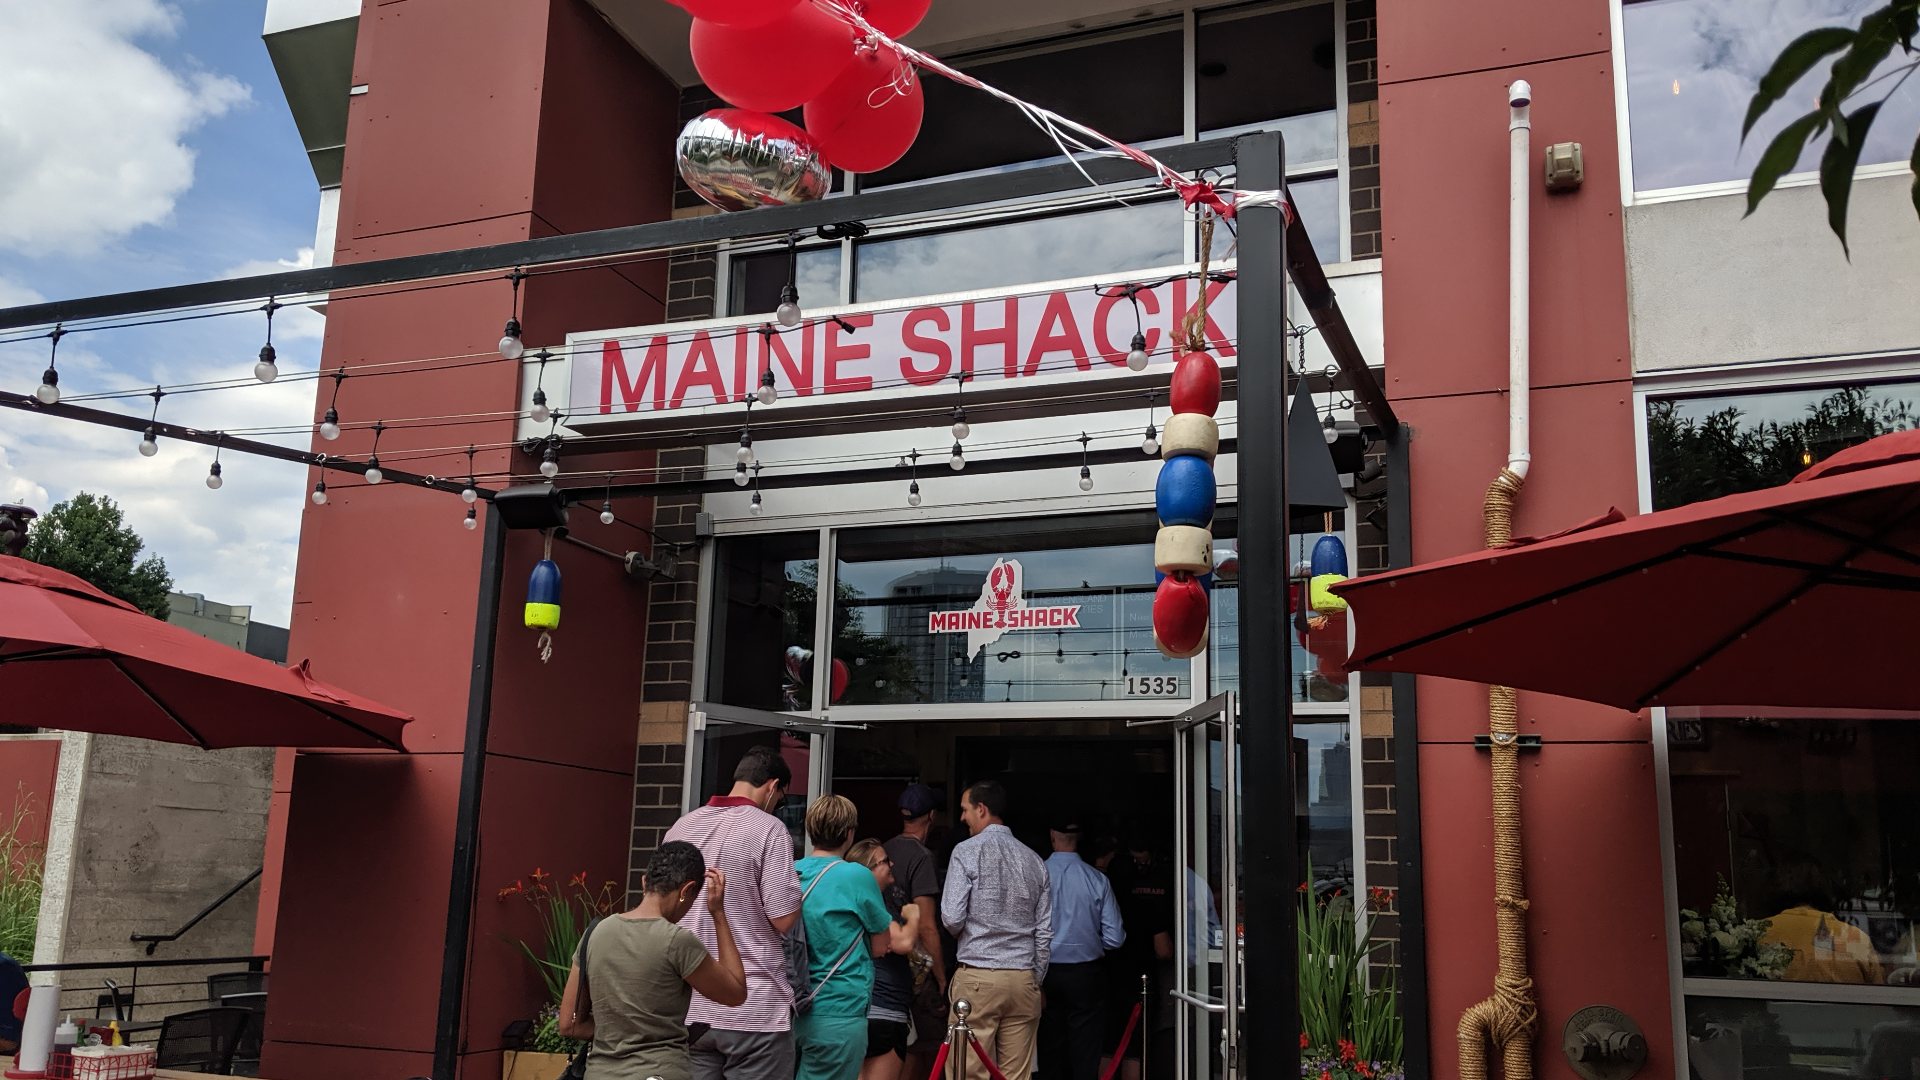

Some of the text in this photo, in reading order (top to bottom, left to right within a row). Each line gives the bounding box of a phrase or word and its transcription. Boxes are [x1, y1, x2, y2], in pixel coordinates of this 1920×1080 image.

[600, 271, 1237, 414] MAINE SHACK
[1040, 594, 1107, 605] NEW ENGLAND
[1124, 592, 1151, 601] LOBS
[1081, 604, 1105, 614] TIES
[930, 607, 1078, 631] MAINE SHACK
[1127, 676, 1178, 695] 1535
[1667, 720, 1702, 741] RIES
